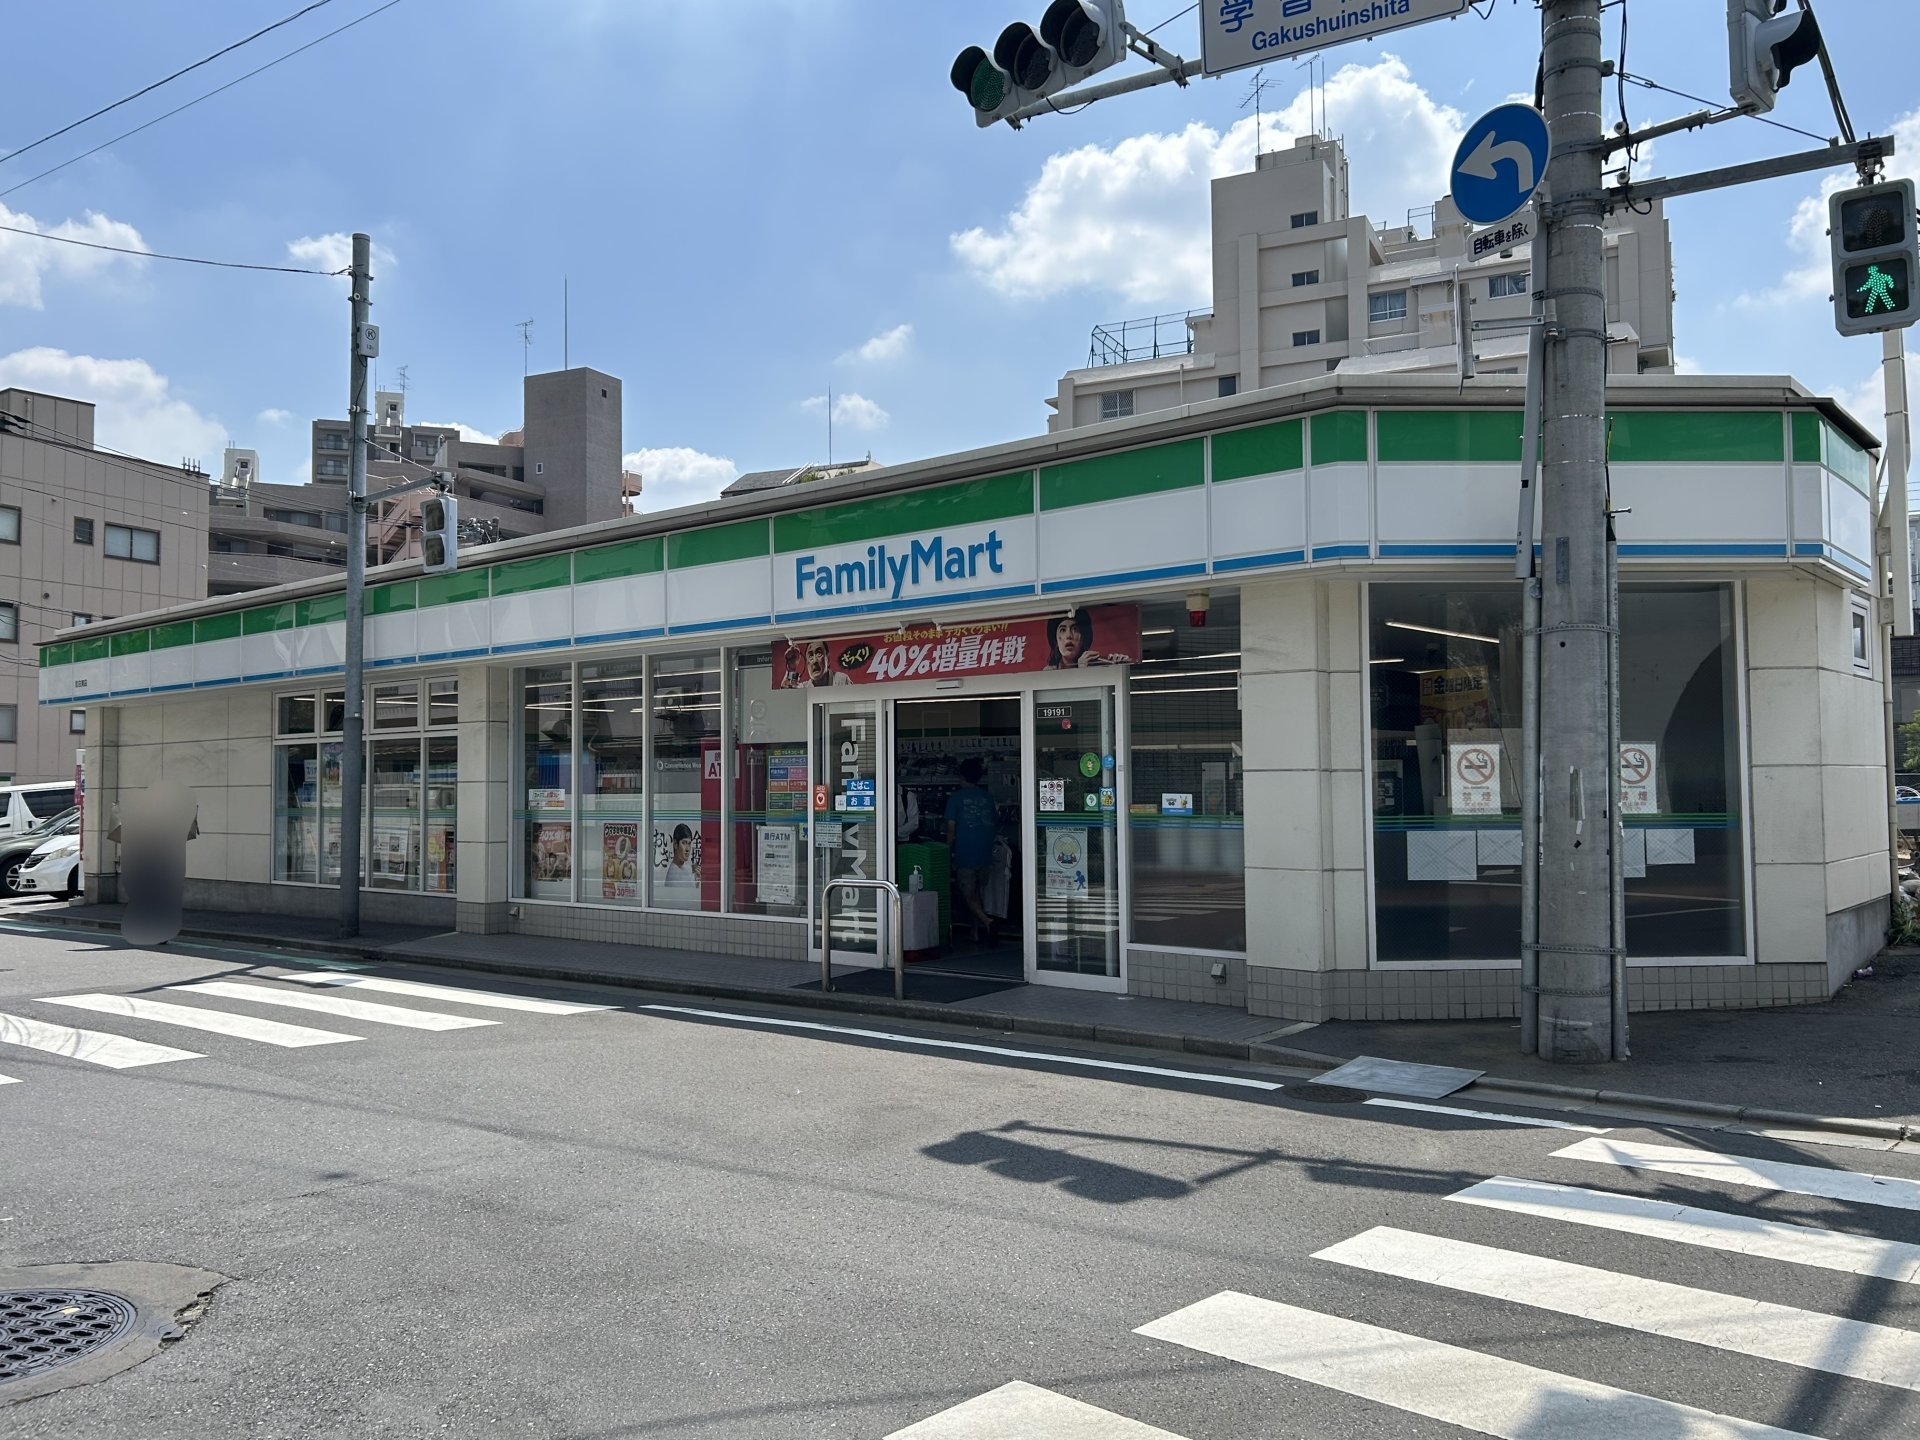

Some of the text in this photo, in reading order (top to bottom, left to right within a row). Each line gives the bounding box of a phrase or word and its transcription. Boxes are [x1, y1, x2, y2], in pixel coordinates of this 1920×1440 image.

[1252, 0, 1411, 50] Gakushuinshita
[1474, 222, 1529, 255] 自転車を除く
[796, 530, 1003, 600] FamilyMart
[866, 634, 1027, 681] 40%増量作戦
[1043, 708, 1065, 717] 19191
[851, 781, 870, 790] たばこ
